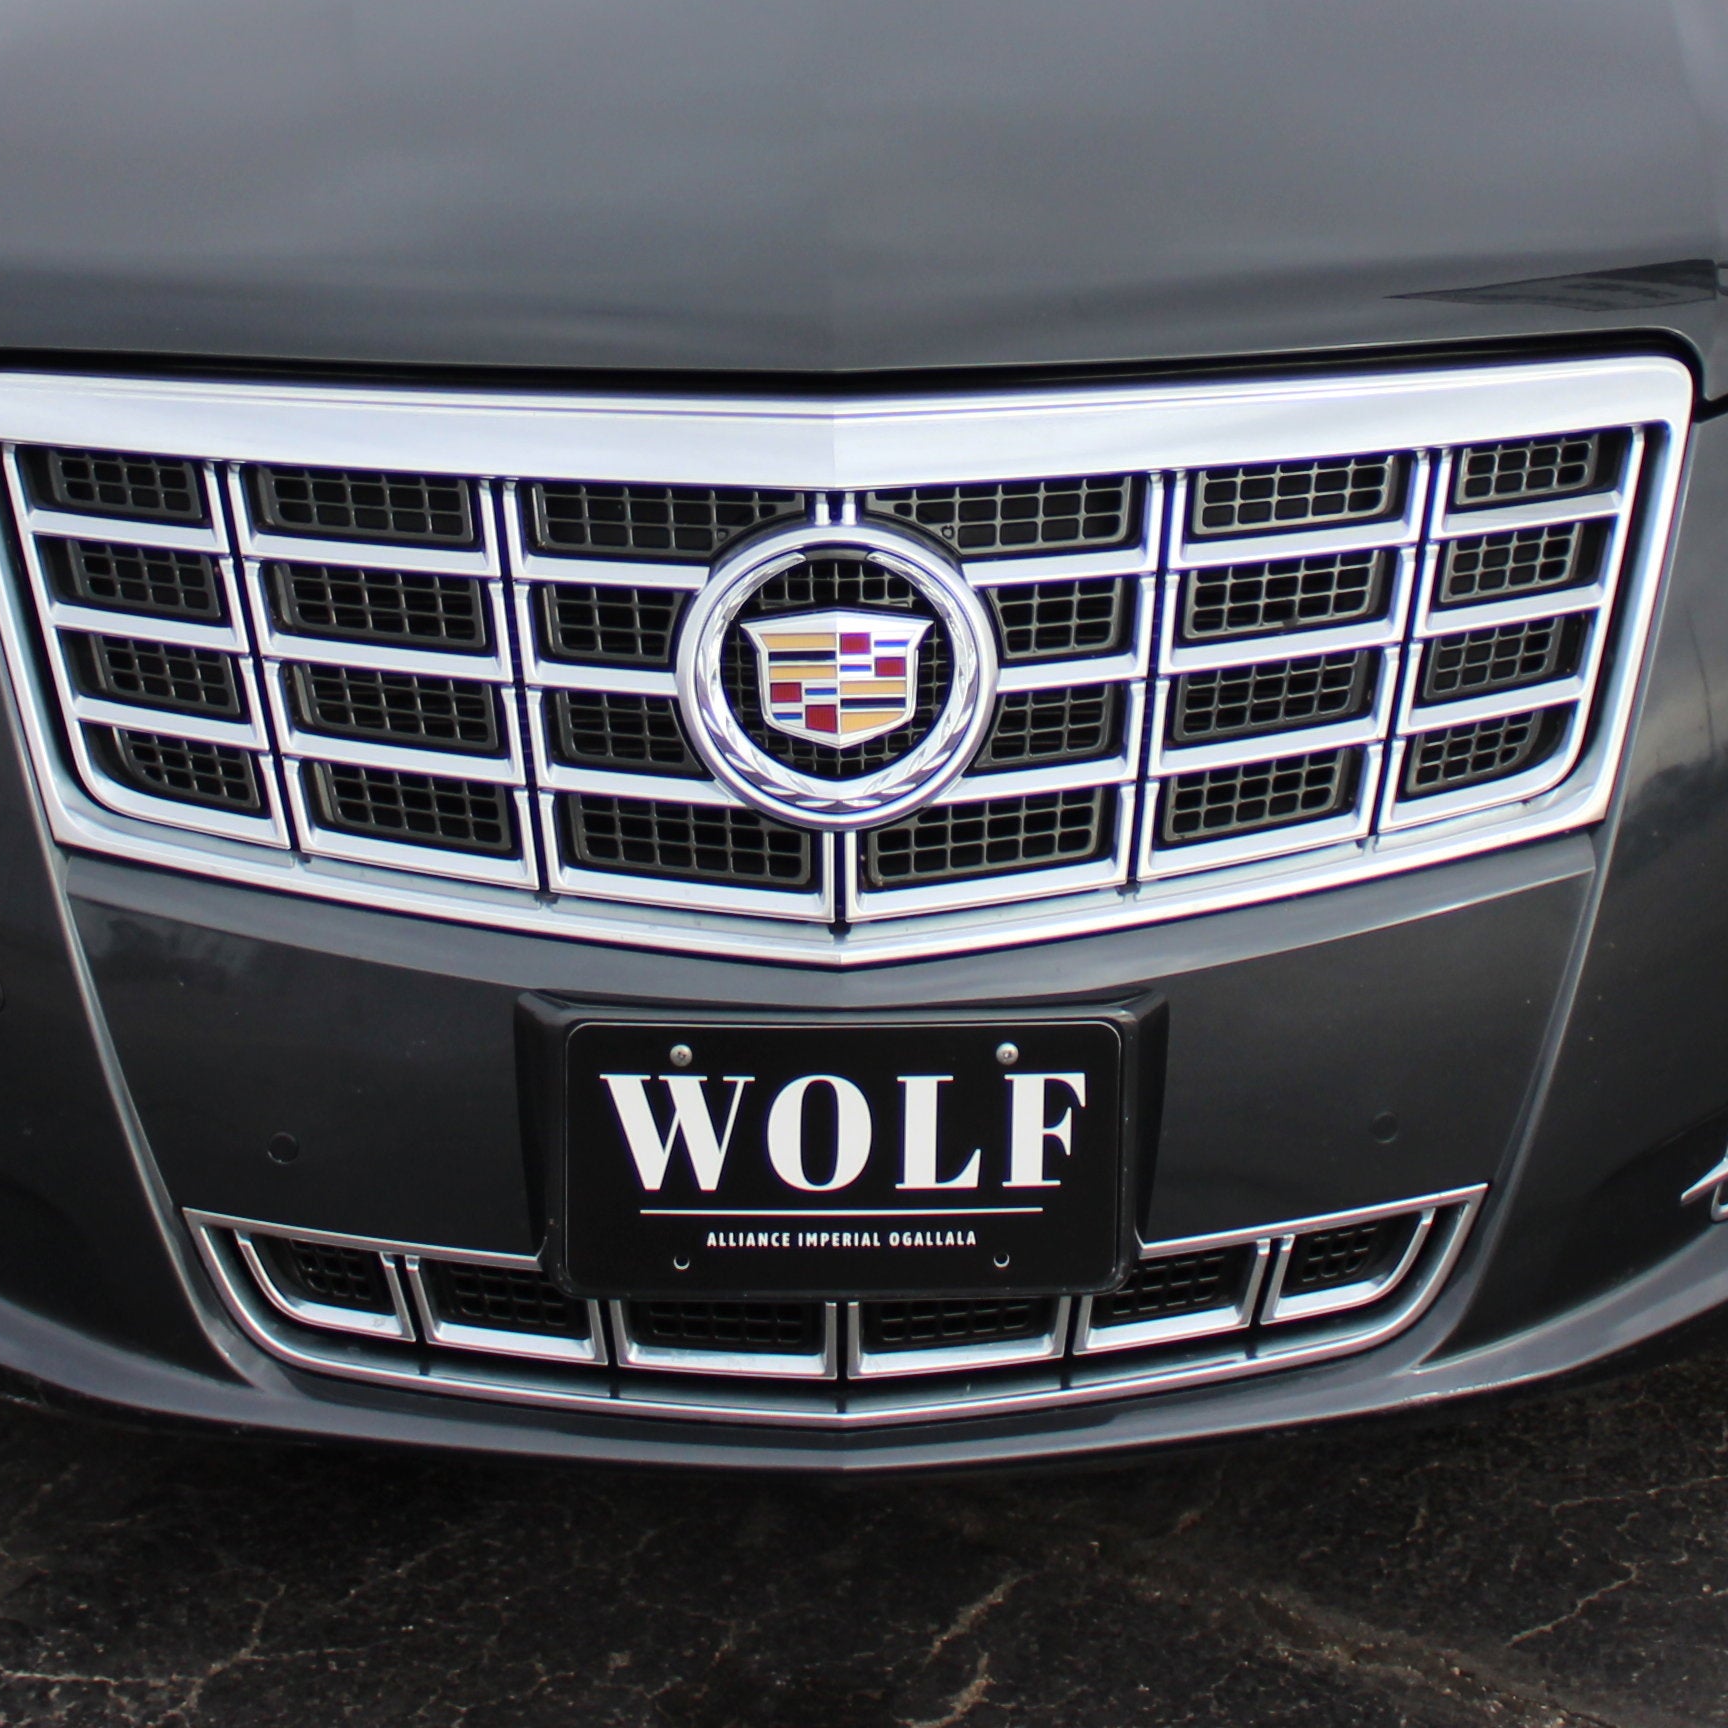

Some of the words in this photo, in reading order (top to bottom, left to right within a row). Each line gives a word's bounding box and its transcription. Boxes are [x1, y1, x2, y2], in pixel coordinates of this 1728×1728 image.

[599, 1072, 1086, 1191] WOLF
[706, 1231, 790, 1248] ALLIANCE
[798, 1231, 881, 1248] IMPERIAL
[888, 1230, 977, 1247] OGALLALA
